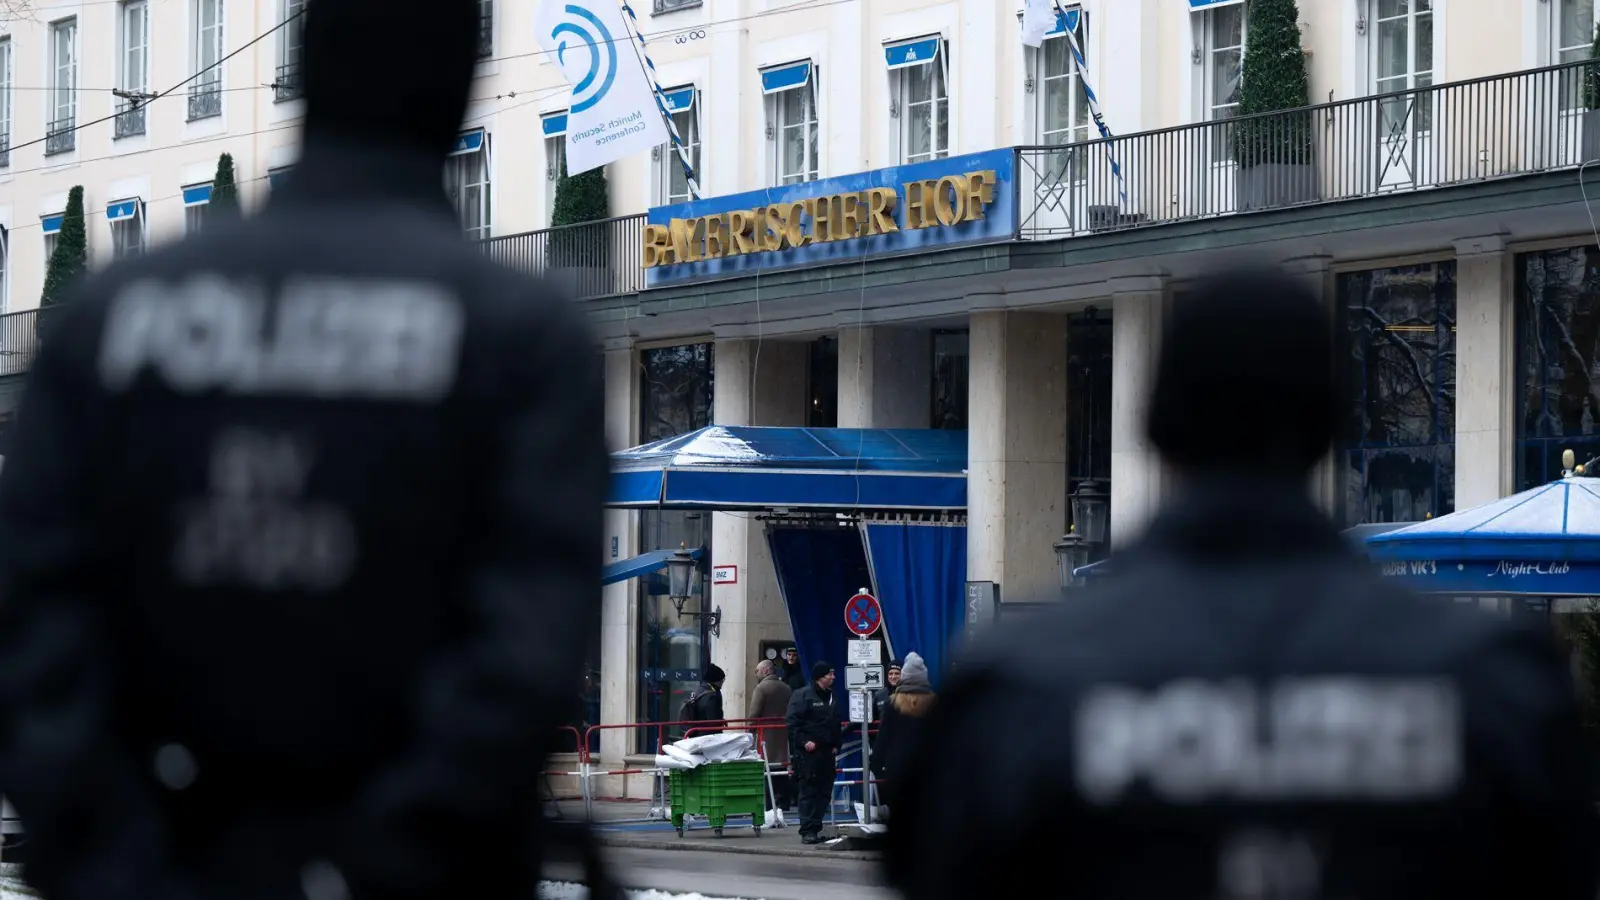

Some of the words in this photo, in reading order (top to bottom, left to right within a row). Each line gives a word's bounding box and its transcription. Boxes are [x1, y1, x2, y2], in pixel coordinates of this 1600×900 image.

[641, 187, 899, 269] BAYERISCHER
[903, 169, 996, 230] HOF
[1411, 560, 1437, 575] VIC'S
[1487, 560, 1532, 579] Night
[1534, 561, 1570, 575] Club
